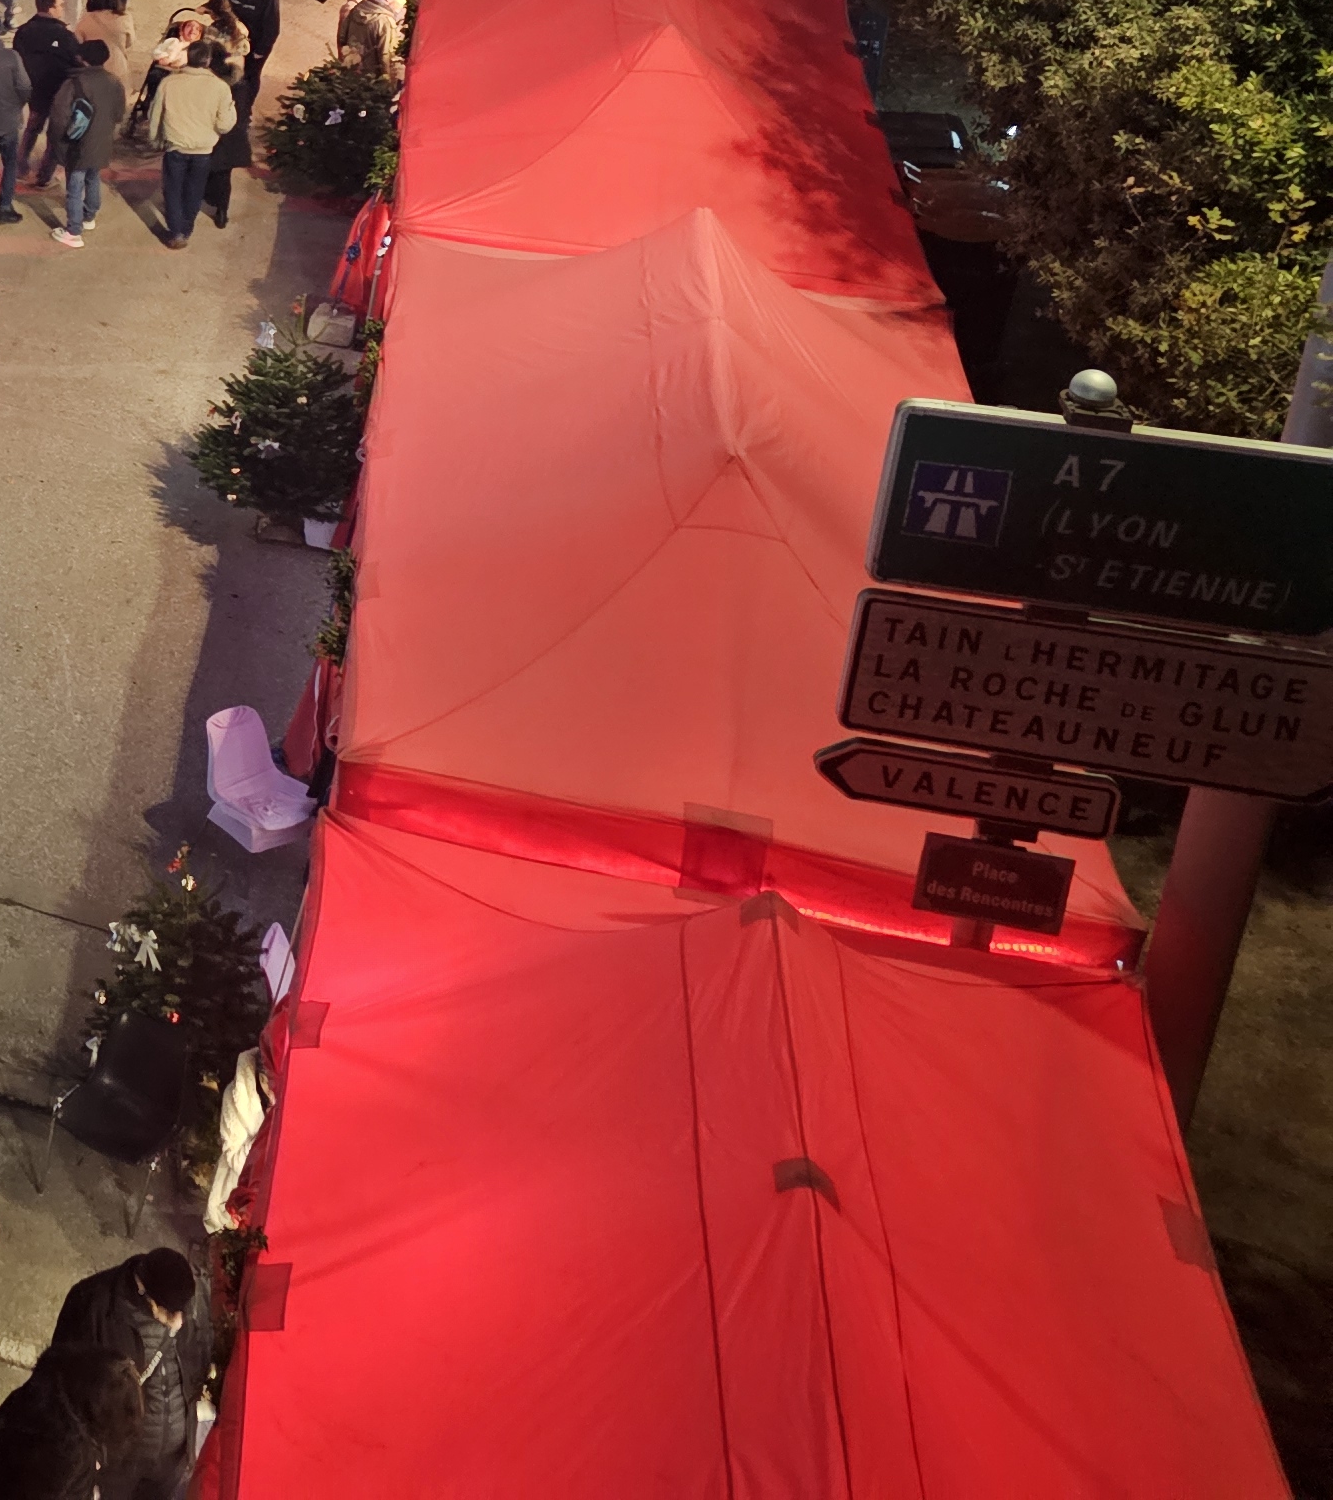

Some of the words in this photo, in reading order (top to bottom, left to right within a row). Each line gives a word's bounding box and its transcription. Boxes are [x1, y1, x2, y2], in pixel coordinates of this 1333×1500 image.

[883, 617, 983, 655] TAIN
[1031, 639, 1310, 704] HERMITAGE
[868, 691, 1228, 768] CHATEAUNEUF
[873, 654, 923, 682] LA
[950, 666, 1100, 712] ROCHE
[1120, 703, 1155, 722] DE
[1180, 702, 1303, 741] GLUN
[881, 765, 1092, 820] VALENCE
[926, 881, 956, 900] des
[960, 886, 1054, 918] Rencontres
[972, 861, 1019, 885] Place
